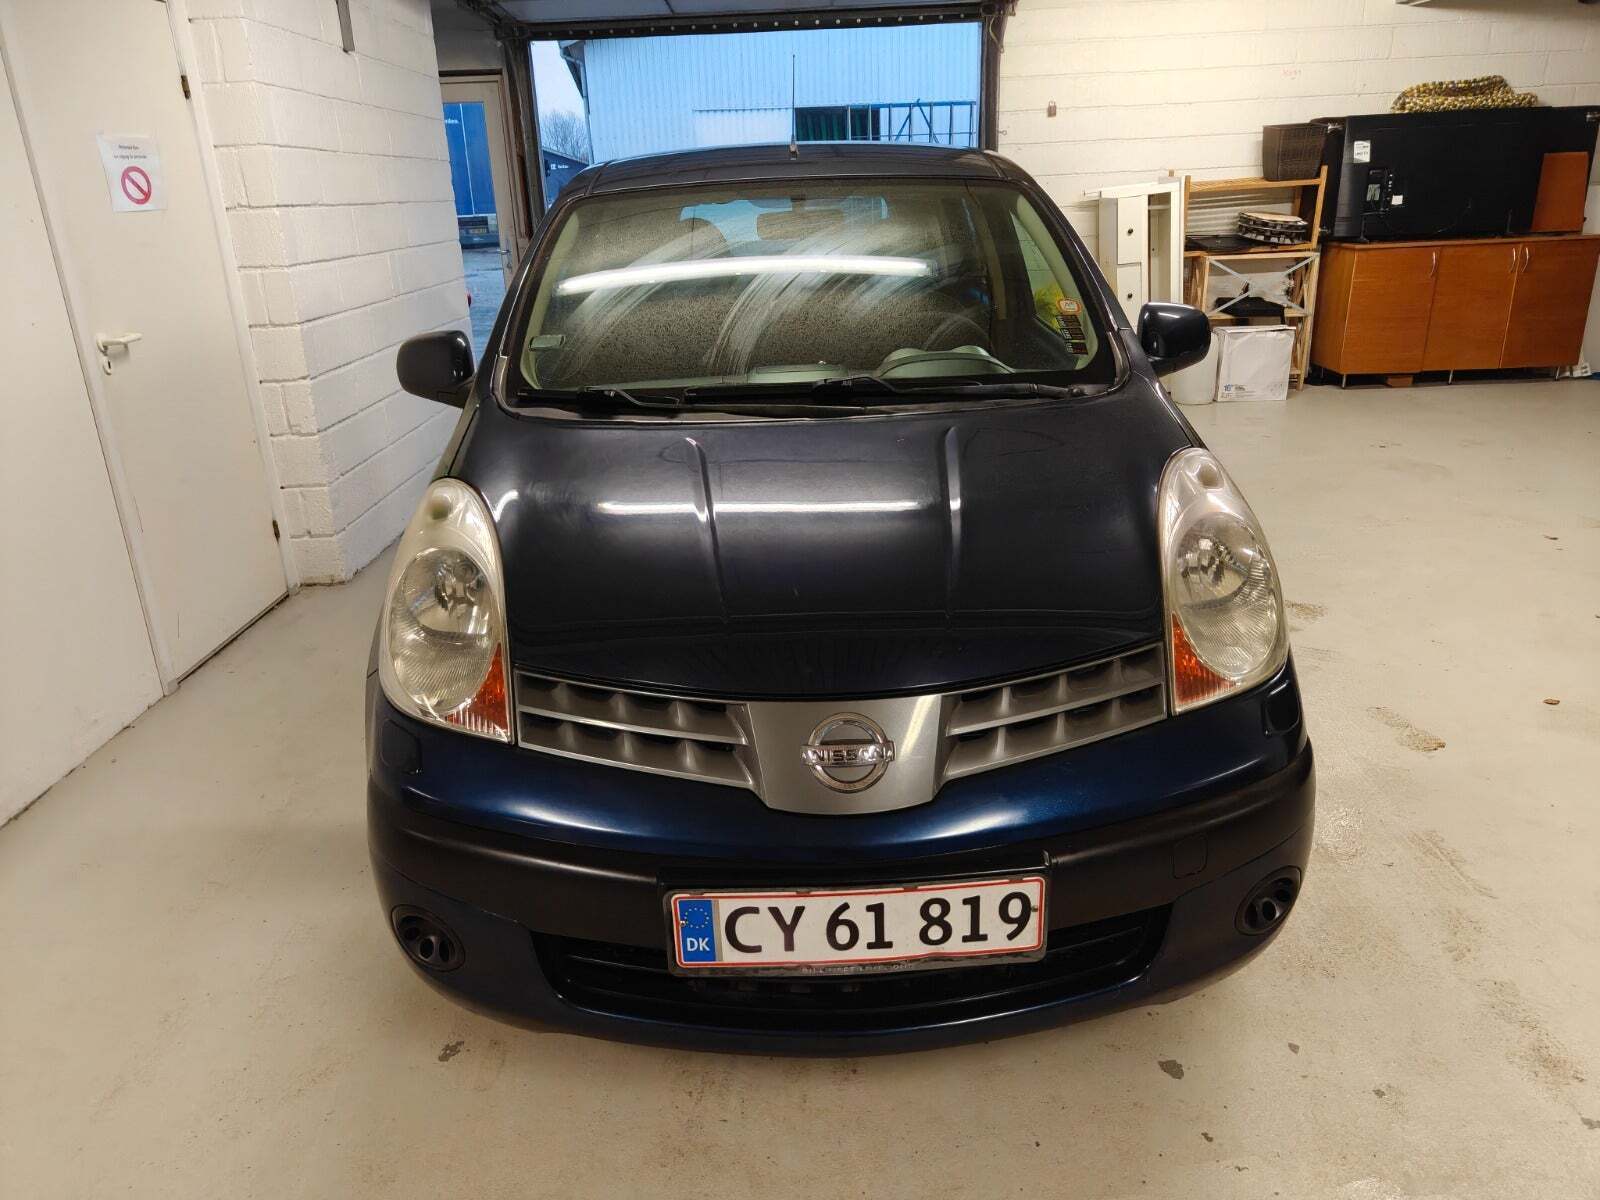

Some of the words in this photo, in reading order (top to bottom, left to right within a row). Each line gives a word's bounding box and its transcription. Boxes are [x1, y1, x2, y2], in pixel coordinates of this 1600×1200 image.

[806, 745, 887, 763] NISSAN
[724, 905, 806, 954] CY
[825, 901, 894, 952] 61
[918, 891, 1033, 946] 819
[685, 937, 711, 952] DK
